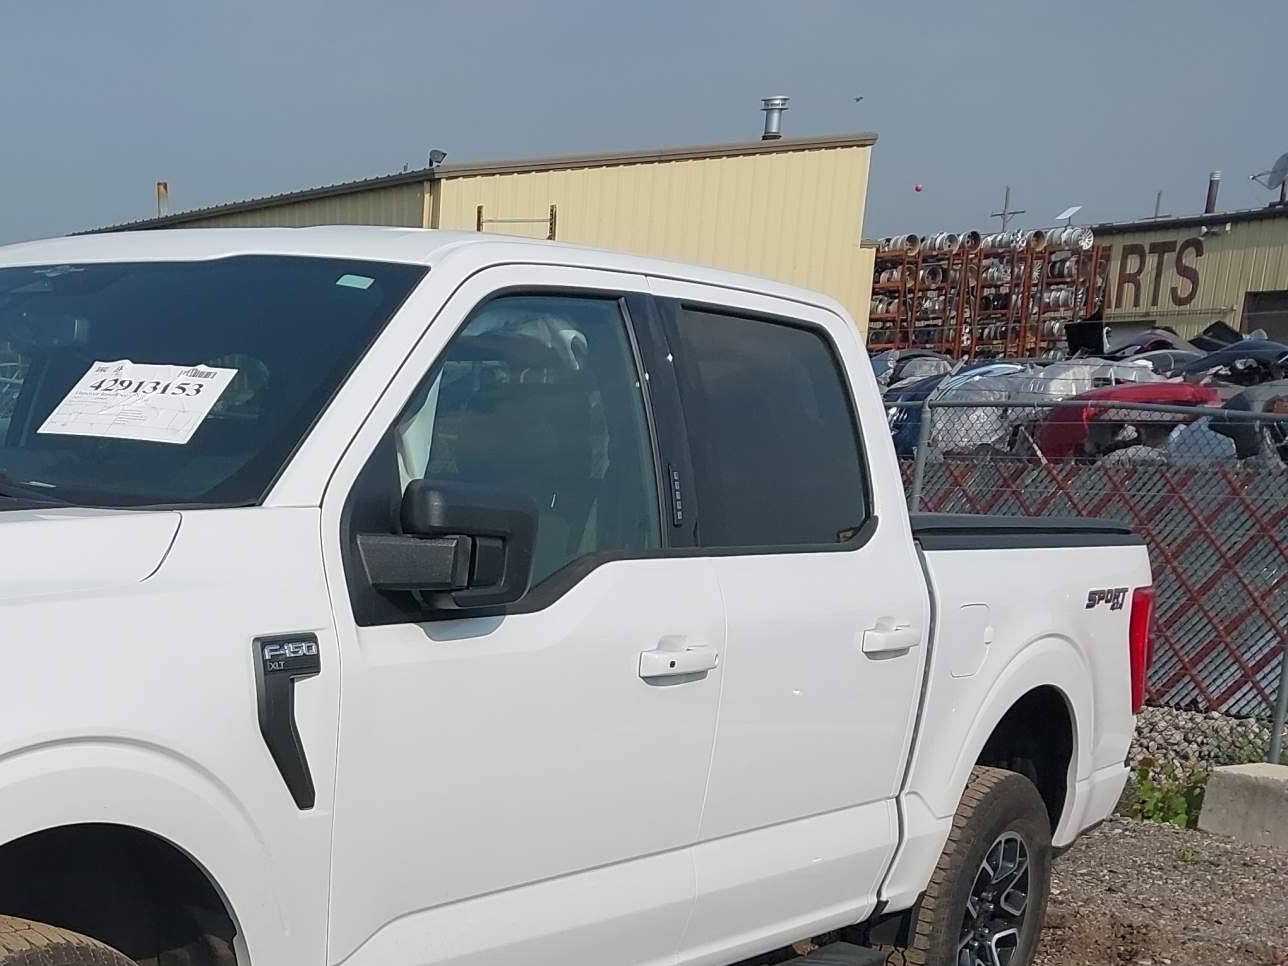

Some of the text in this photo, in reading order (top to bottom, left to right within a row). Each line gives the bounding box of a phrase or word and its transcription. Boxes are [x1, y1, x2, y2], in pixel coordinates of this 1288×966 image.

[89, 377, 205, 397] 42913153
[1085, 587, 1129, 610] SPORT
[263, 641, 318, 660] F-150
[269, 661, 286, 670] XLT
